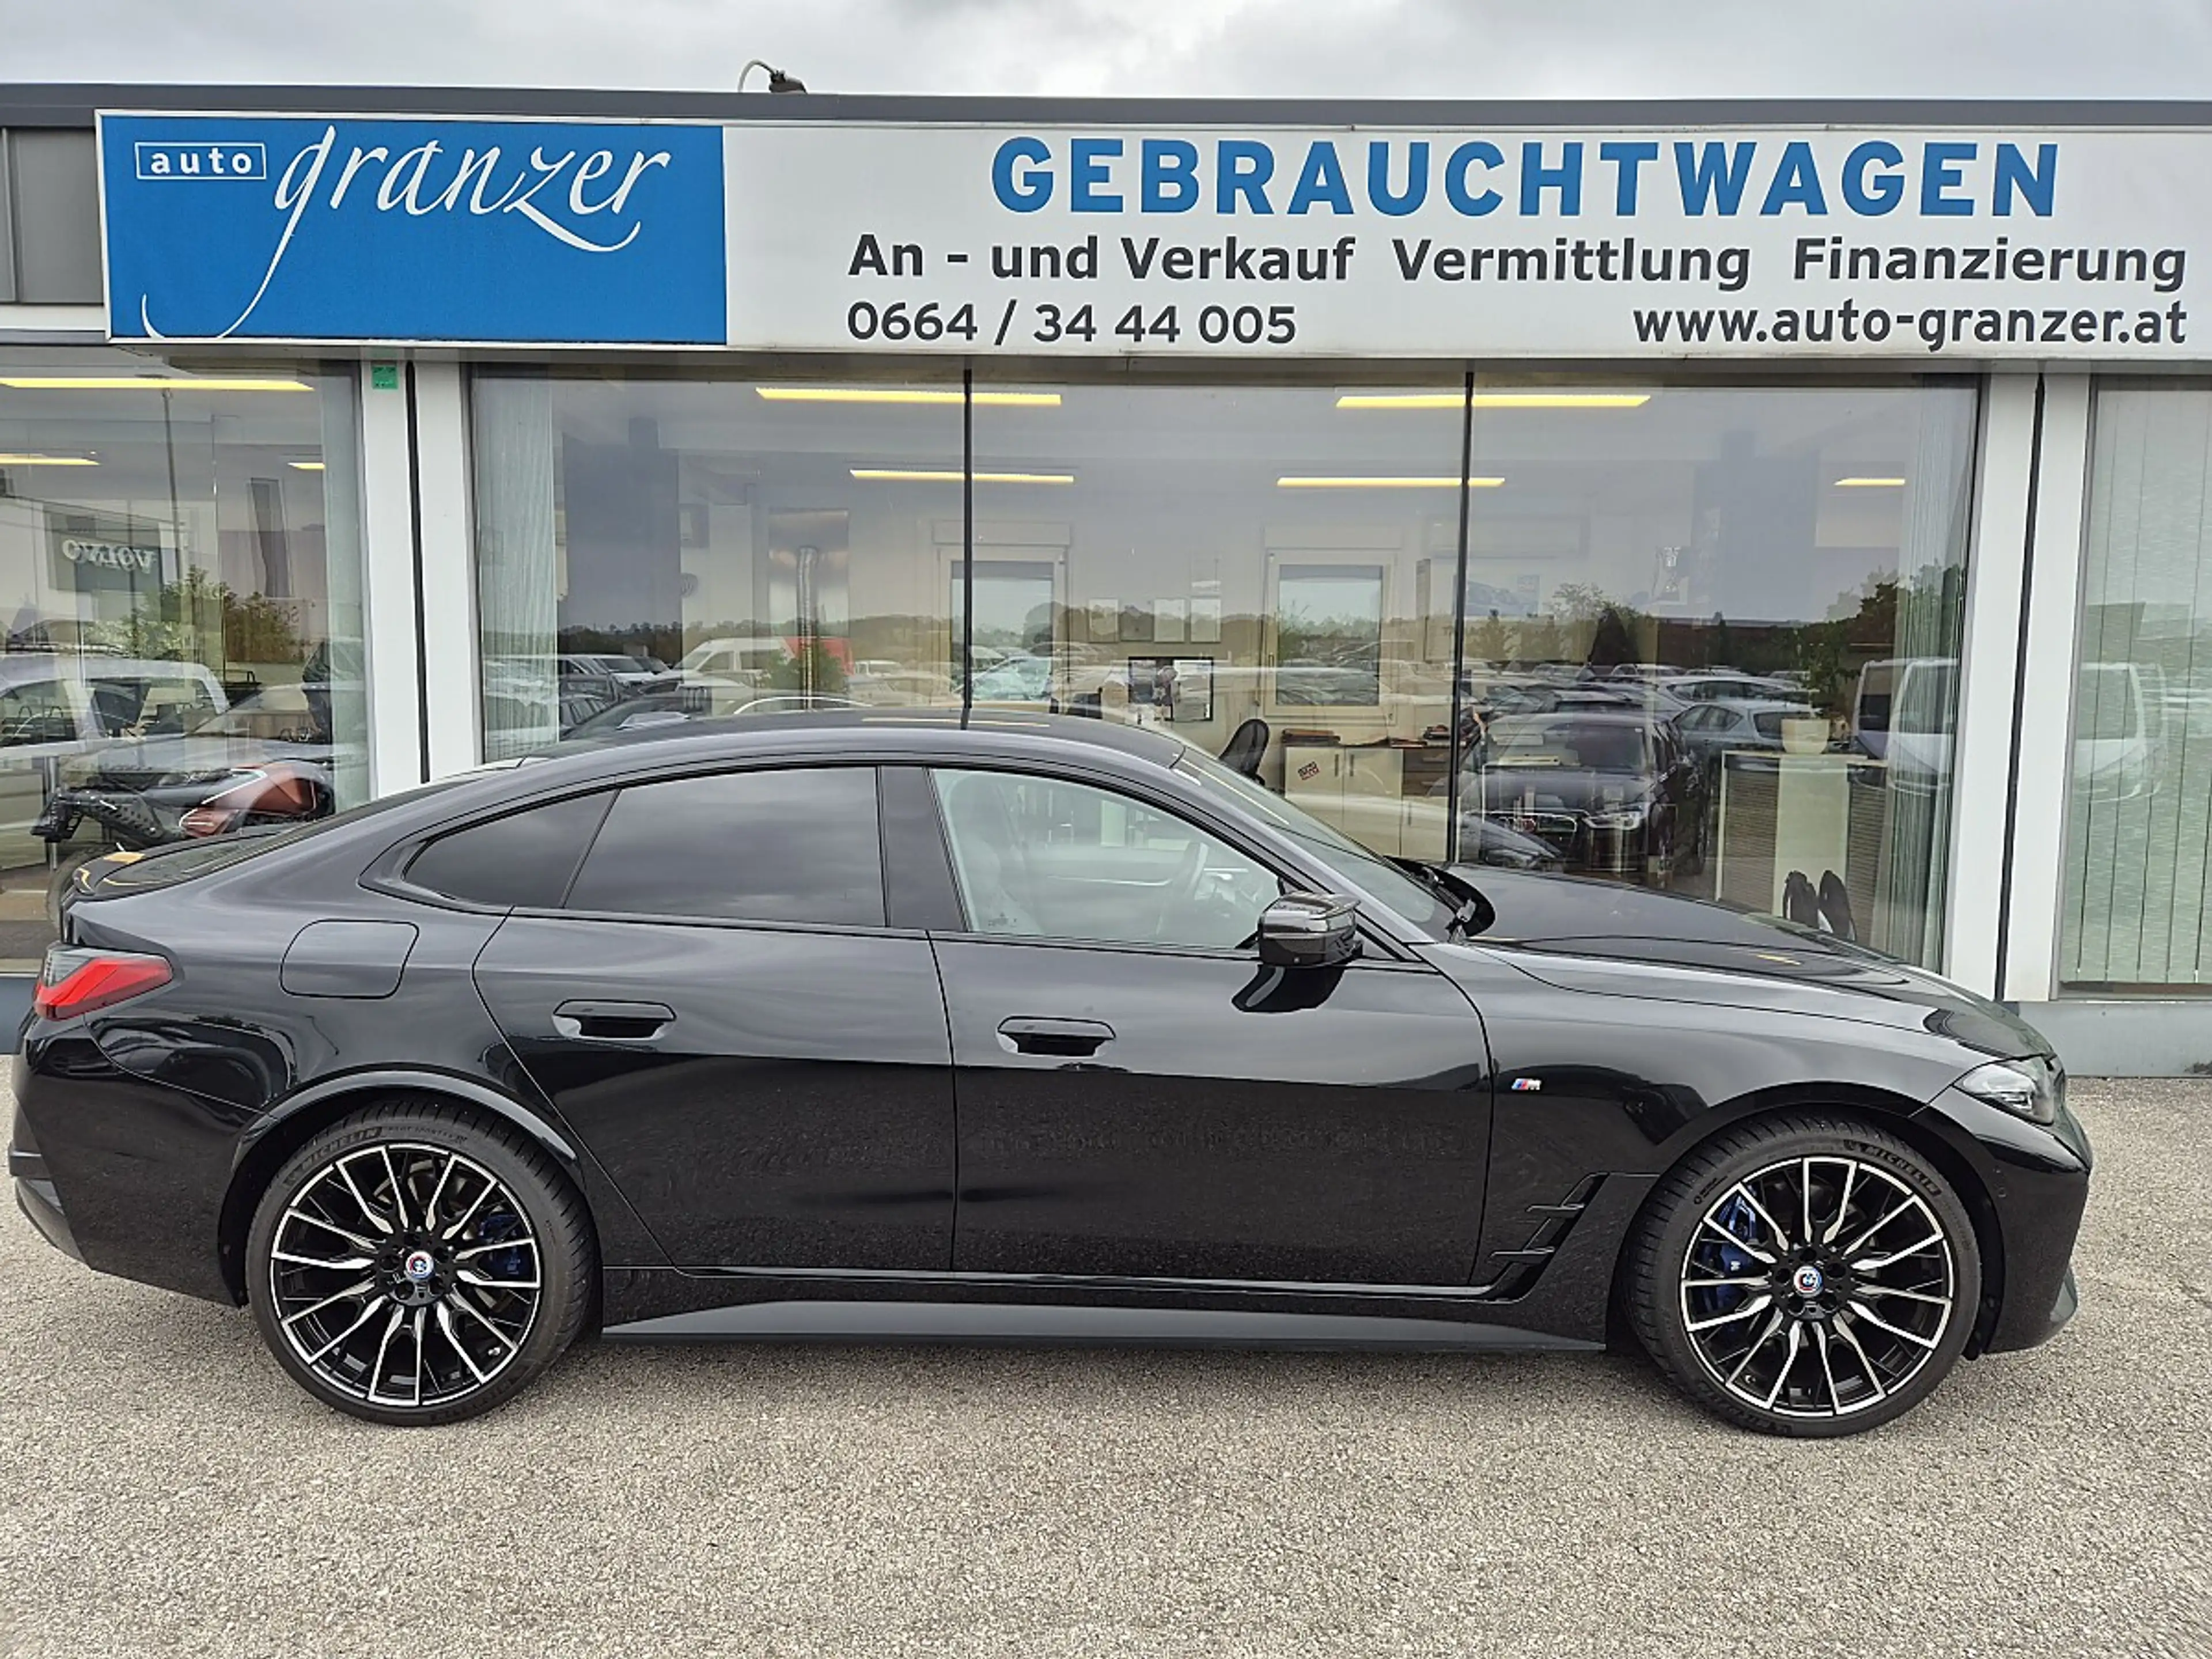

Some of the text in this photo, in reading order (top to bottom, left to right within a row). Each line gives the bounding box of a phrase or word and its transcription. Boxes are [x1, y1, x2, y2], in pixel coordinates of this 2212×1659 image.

[992, 137, 2058, 218] GEBRAUCHTWAGEN
[141, 125, 671, 339] auto granzer
[848, 234, 923, 276] An
[992, 235, 1098, 279] und
[1120, 236, 1356, 281] Verkauf
[1392, 237, 1750, 291] Vermittlung
[1794, 236, 2186, 293] Finanzierung
[848, 301, 978, 340] 0664
[1033, 304, 1097, 342] 34
[1115, 305, 1180, 343] 44
[1199, 305, 1296, 344] 005
[1633, 298, 2187, 353] www.auto-granzer.at
